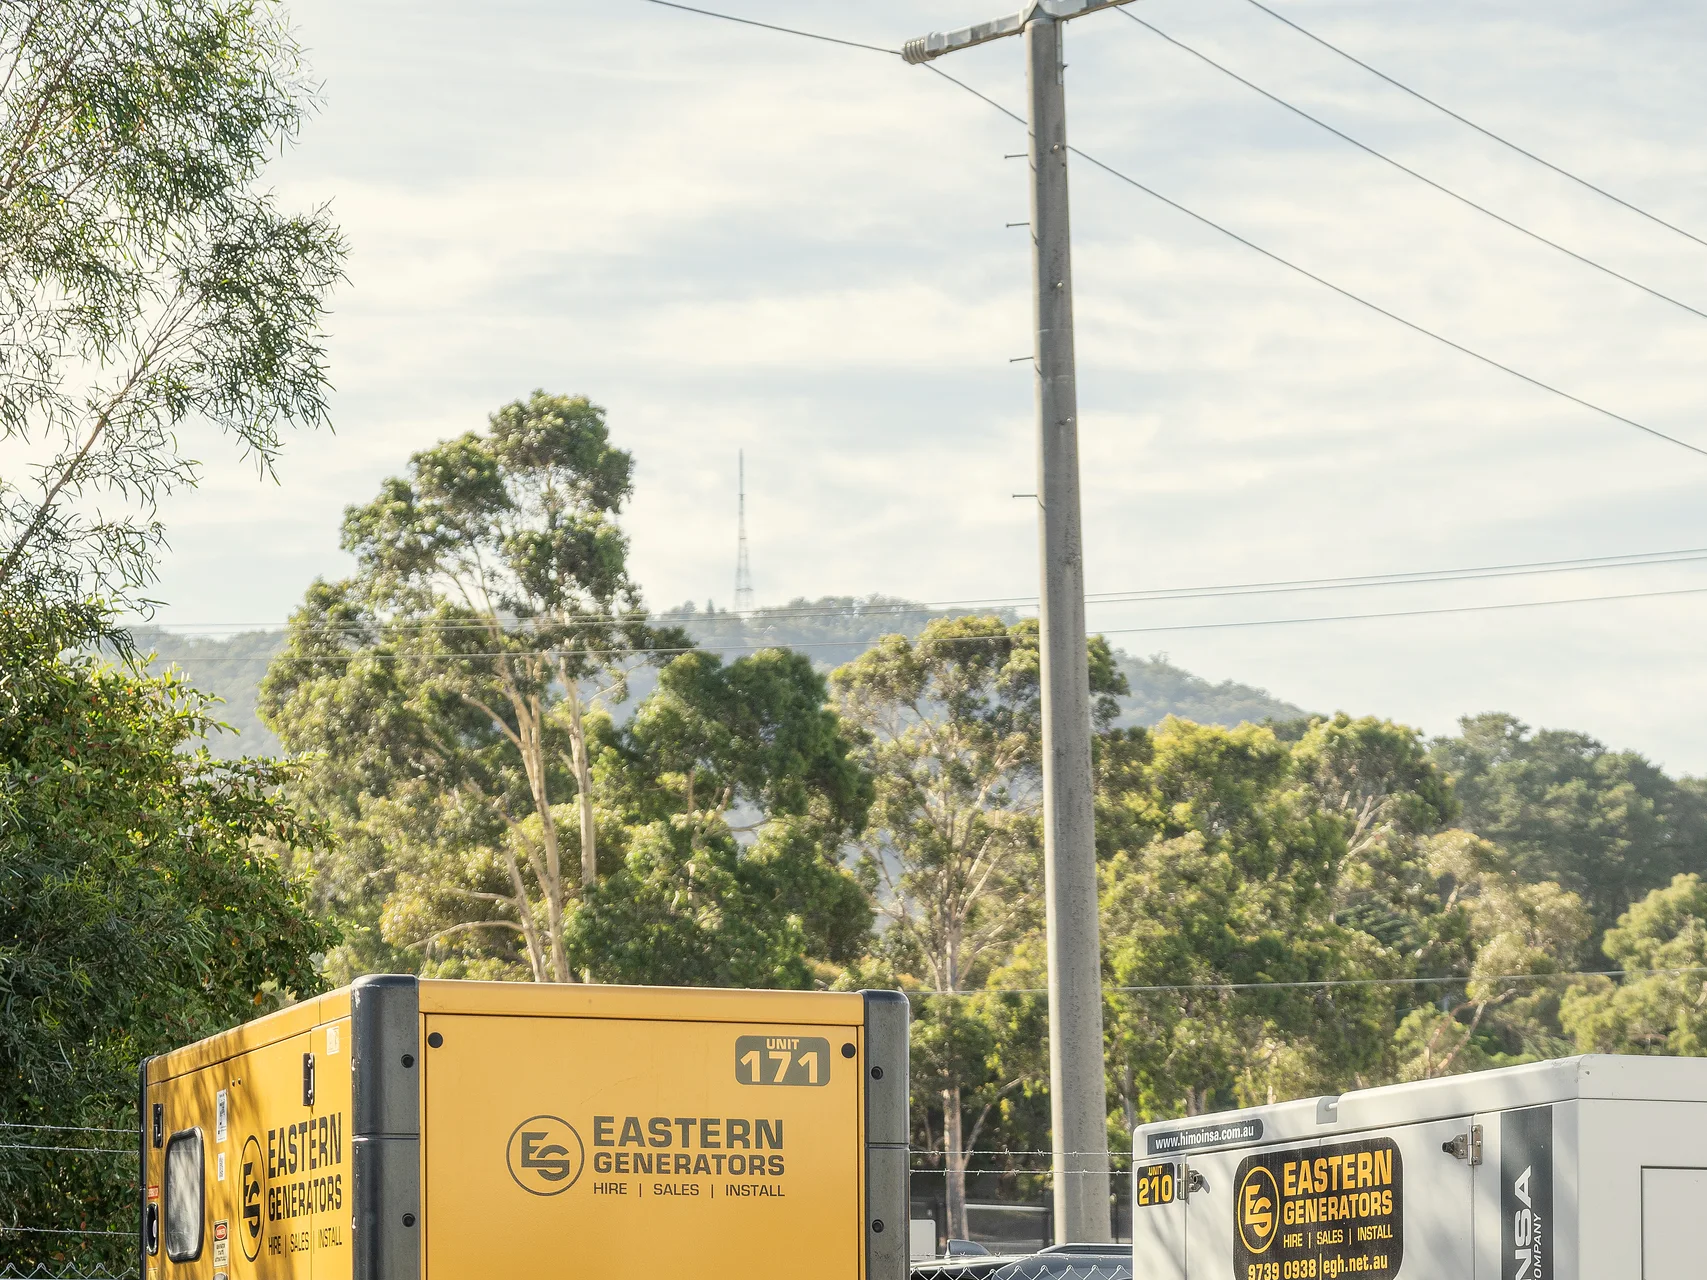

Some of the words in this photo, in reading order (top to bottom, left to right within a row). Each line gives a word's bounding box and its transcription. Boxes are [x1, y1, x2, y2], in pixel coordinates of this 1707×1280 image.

[766, 1038, 800, 1050] UNIT
[740, 1051, 818, 1084] 171
[268, 1112, 342, 1178] EASTERN
[593, 1115, 784, 1150] EASTERN
[1155, 1125, 1254, 1150] www.himoinsa.com.au
[593, 1152, 785, 1176] GENERATORS
[1148, 1165, 1163, 1176] UNIT
[1283, 1148, 1393, 1197] EASTERN
[268, 1173, 342, 1222] GENERATORS
[593, 1182, 628, 1196] HIRE
[653, 1183, 700, 1197] SALES
[725, 1184, 786, 1198] INSTALL
[1138, 1174, 1173, 1205] 210
[1283, 1189, 1393, 1225] GENERATORS
[268, 1236, 282, 1256] HIRE
[290, 1231, 309, 1253] SALES
[318, 1226, 343, 1249] INSTALL
[1283, 1232, 1303, 1249] HIRE
[1316, 1229, 1344, 1245] SALES
[1357, 1223, 1393, 1242] INSTALL
[1283, 1258, 1317, 1280] 0938
[1323, 1253, 1388, 1279] egh.net.au
